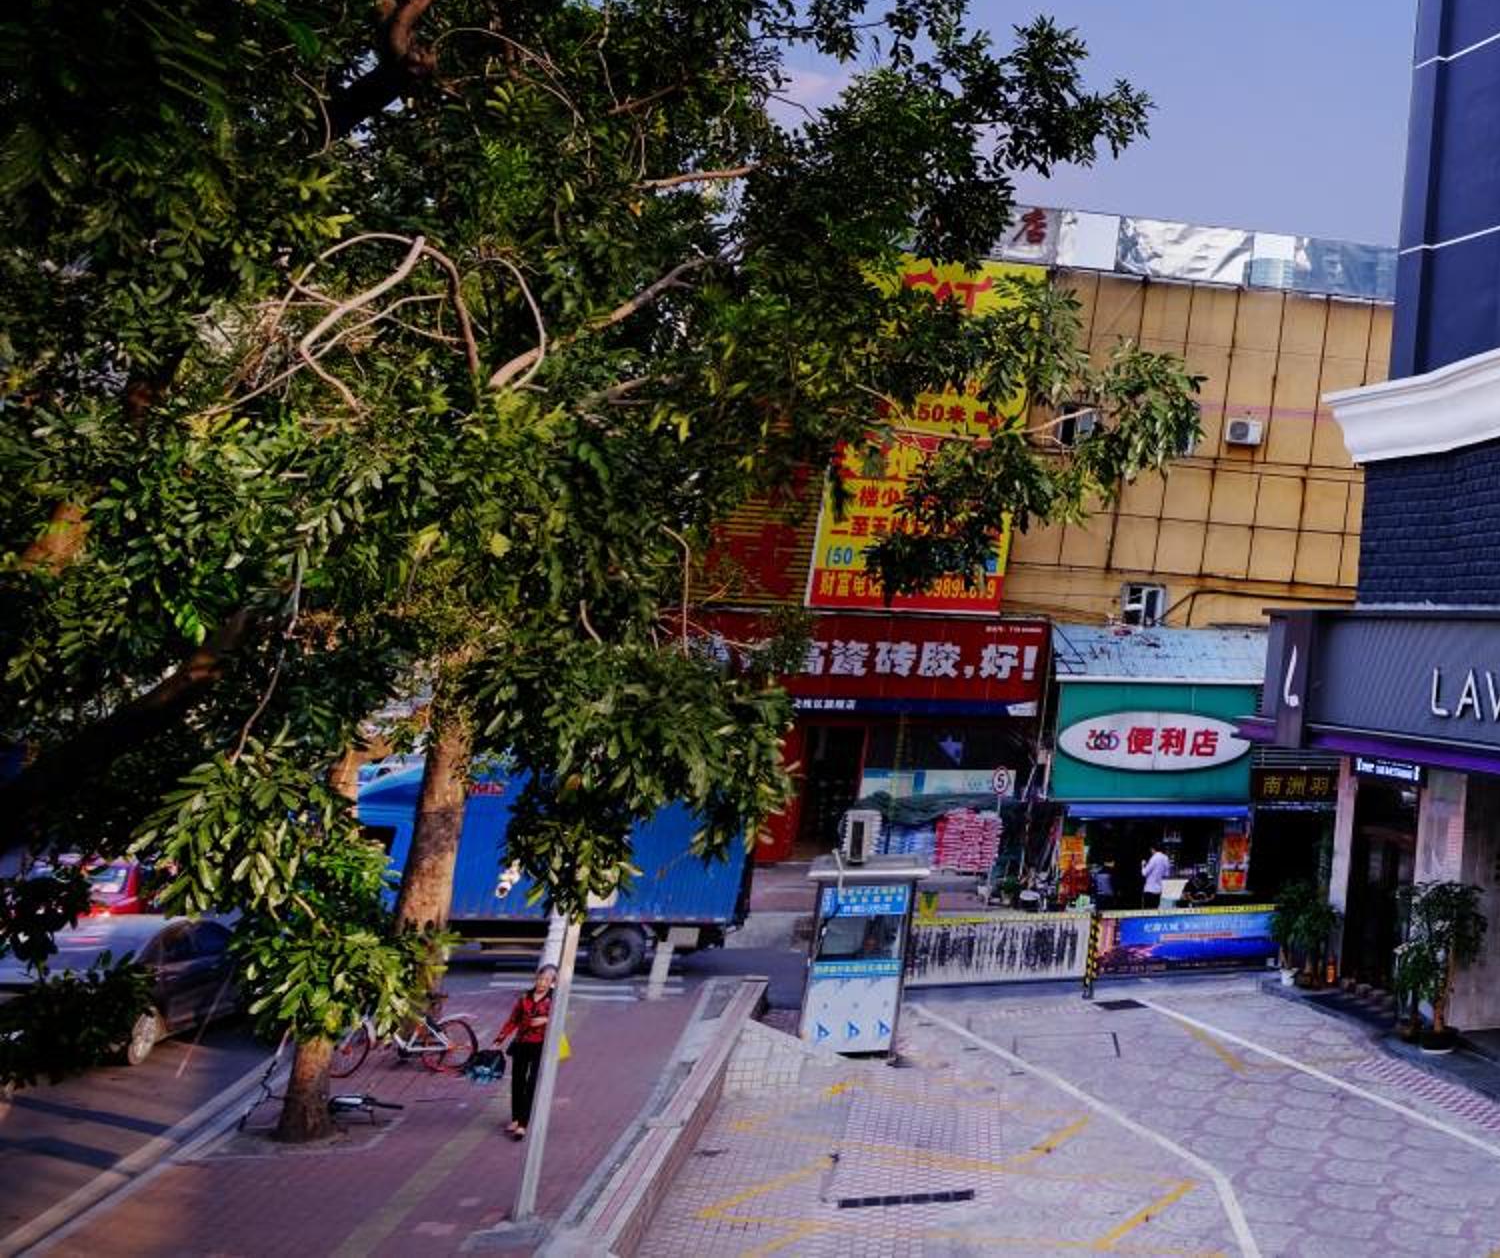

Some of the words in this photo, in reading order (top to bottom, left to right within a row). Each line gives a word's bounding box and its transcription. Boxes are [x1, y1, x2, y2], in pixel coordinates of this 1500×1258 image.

[1127, 727, 1218, 757] 便利店
[996, 773, 1005, 789] 5
[1263, 775, 1338, 797] 南洲羽
